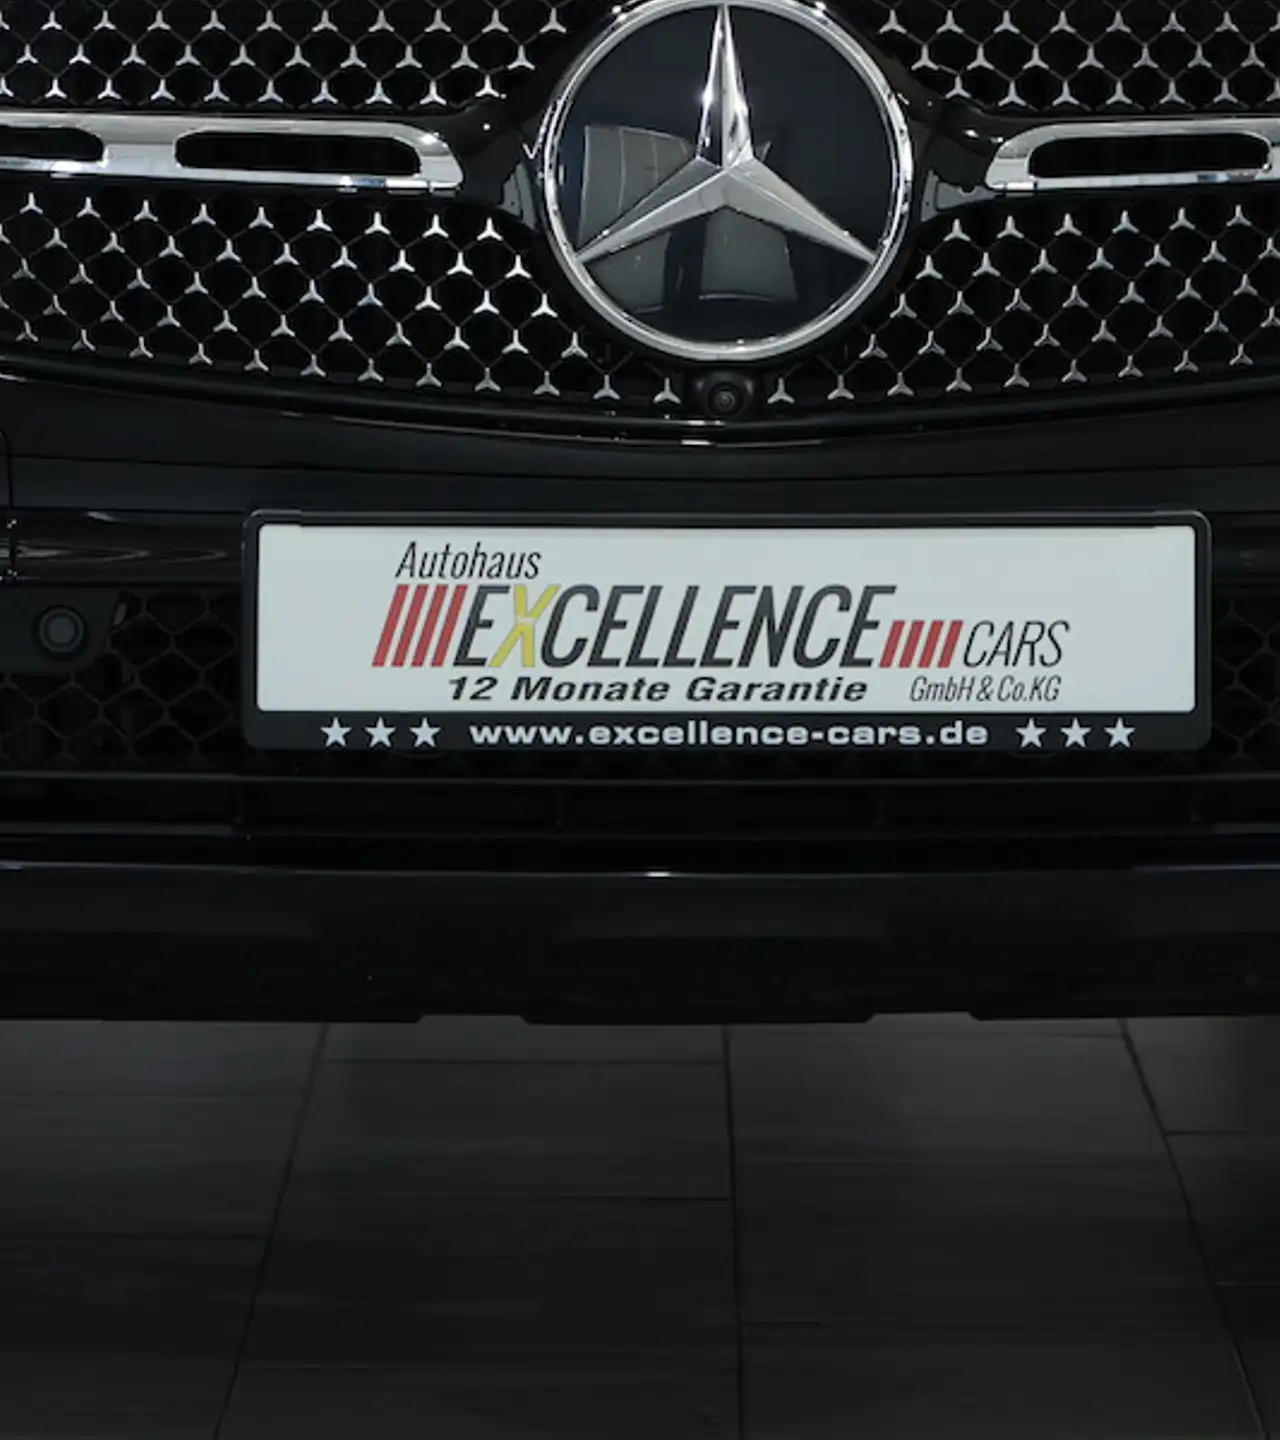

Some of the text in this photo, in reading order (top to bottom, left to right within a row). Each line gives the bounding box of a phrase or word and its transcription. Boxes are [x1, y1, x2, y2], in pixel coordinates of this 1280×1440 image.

[394, 540, 542, 580] Autohaus
[453, 584, 1071, 669] EXCELLENCE CARS
[449, 675, 868, 702] 12 Monate Garantie
[909, 674, 975, 702] GmbH
[469, 719, 989, 746] www.excellence-cars.de
